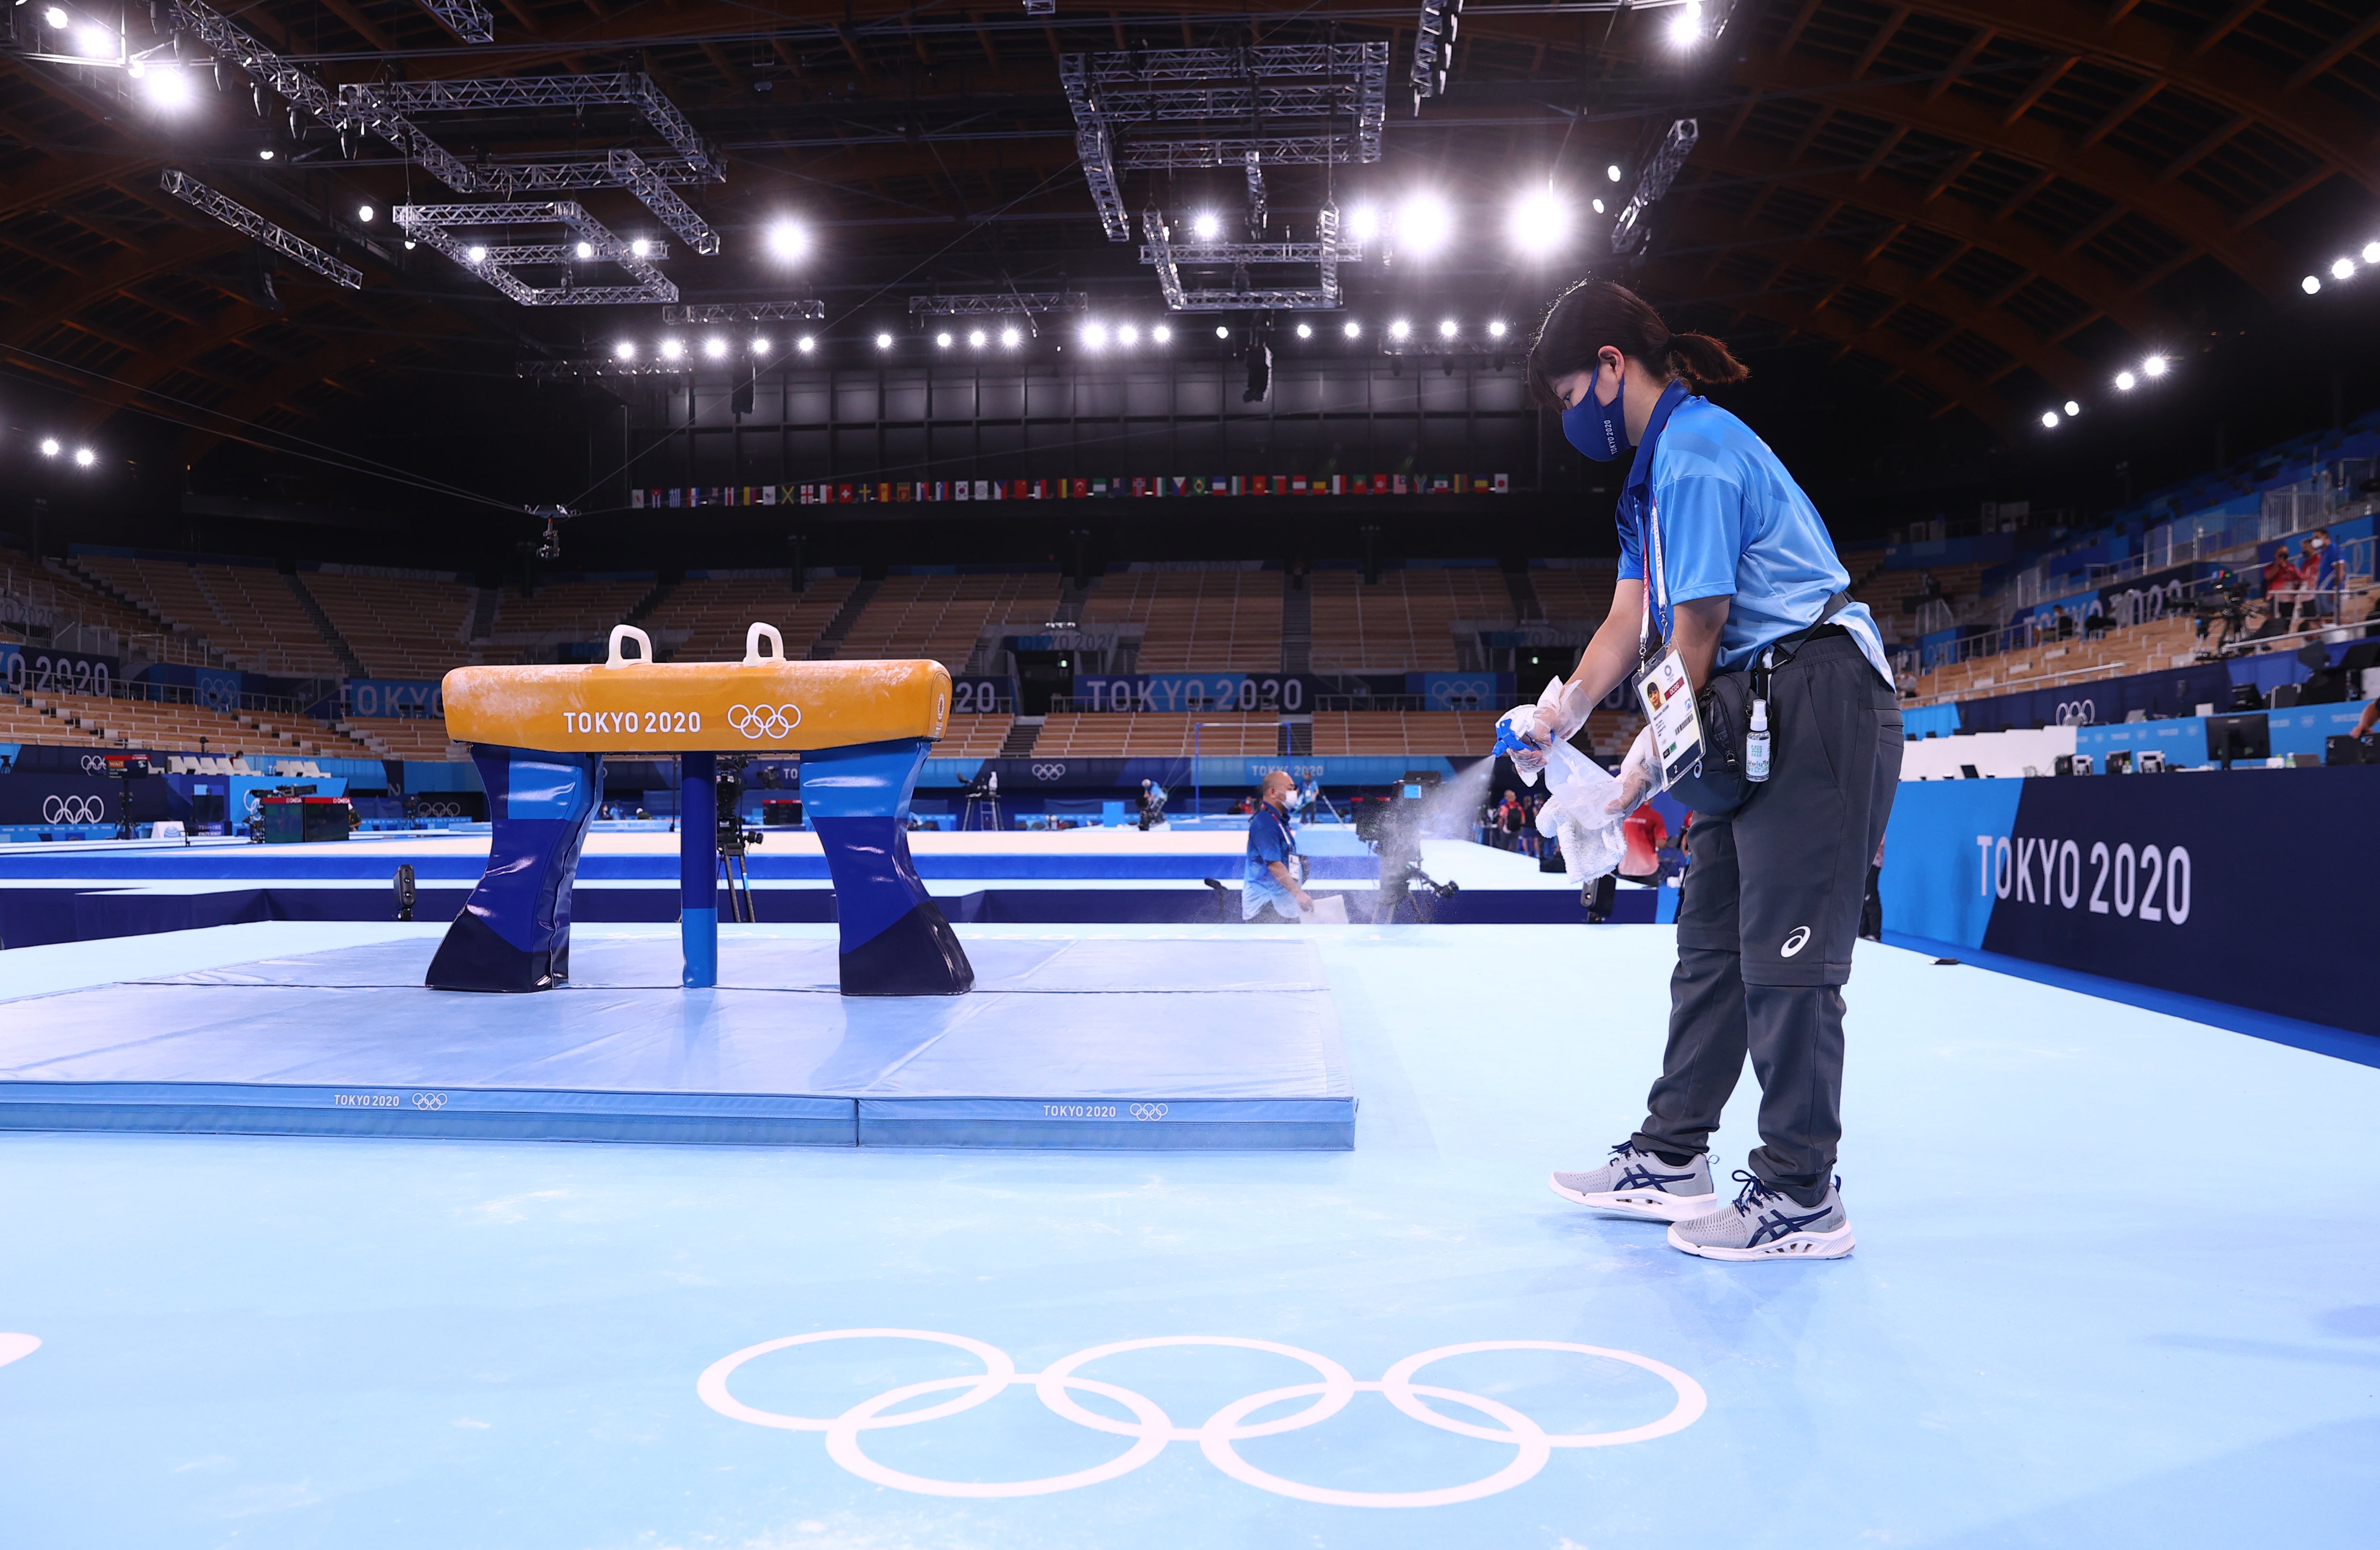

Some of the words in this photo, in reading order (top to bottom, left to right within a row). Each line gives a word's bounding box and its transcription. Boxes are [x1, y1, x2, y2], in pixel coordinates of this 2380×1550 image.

[1604, 420, 1615, 436] 2020
[1607, 437, 1618, 455] TOKYO
[36, 655, 109, 697] 2020
[1086, 680, 1205, 712] TOKYO
[1216, 679, 1303, 711] 2020
[1669, 682, 1680, 695] OCOG
[563, 712, 638, 733] TOKYO
[644, 711, 701, 733] 2020
[1294, 765, 1324, 777] 2020
[1976, 835, 2080, 909] TOKYO
[2089, 841, 2191, 925] 2020
[334, 1094, 370, 1106] TOKYO
[372, 1095, 400, 1106] 2020
[1043, 1105, 1083, 1117] TOKYO
[1086, 1106, 1116, 1117] 2020
